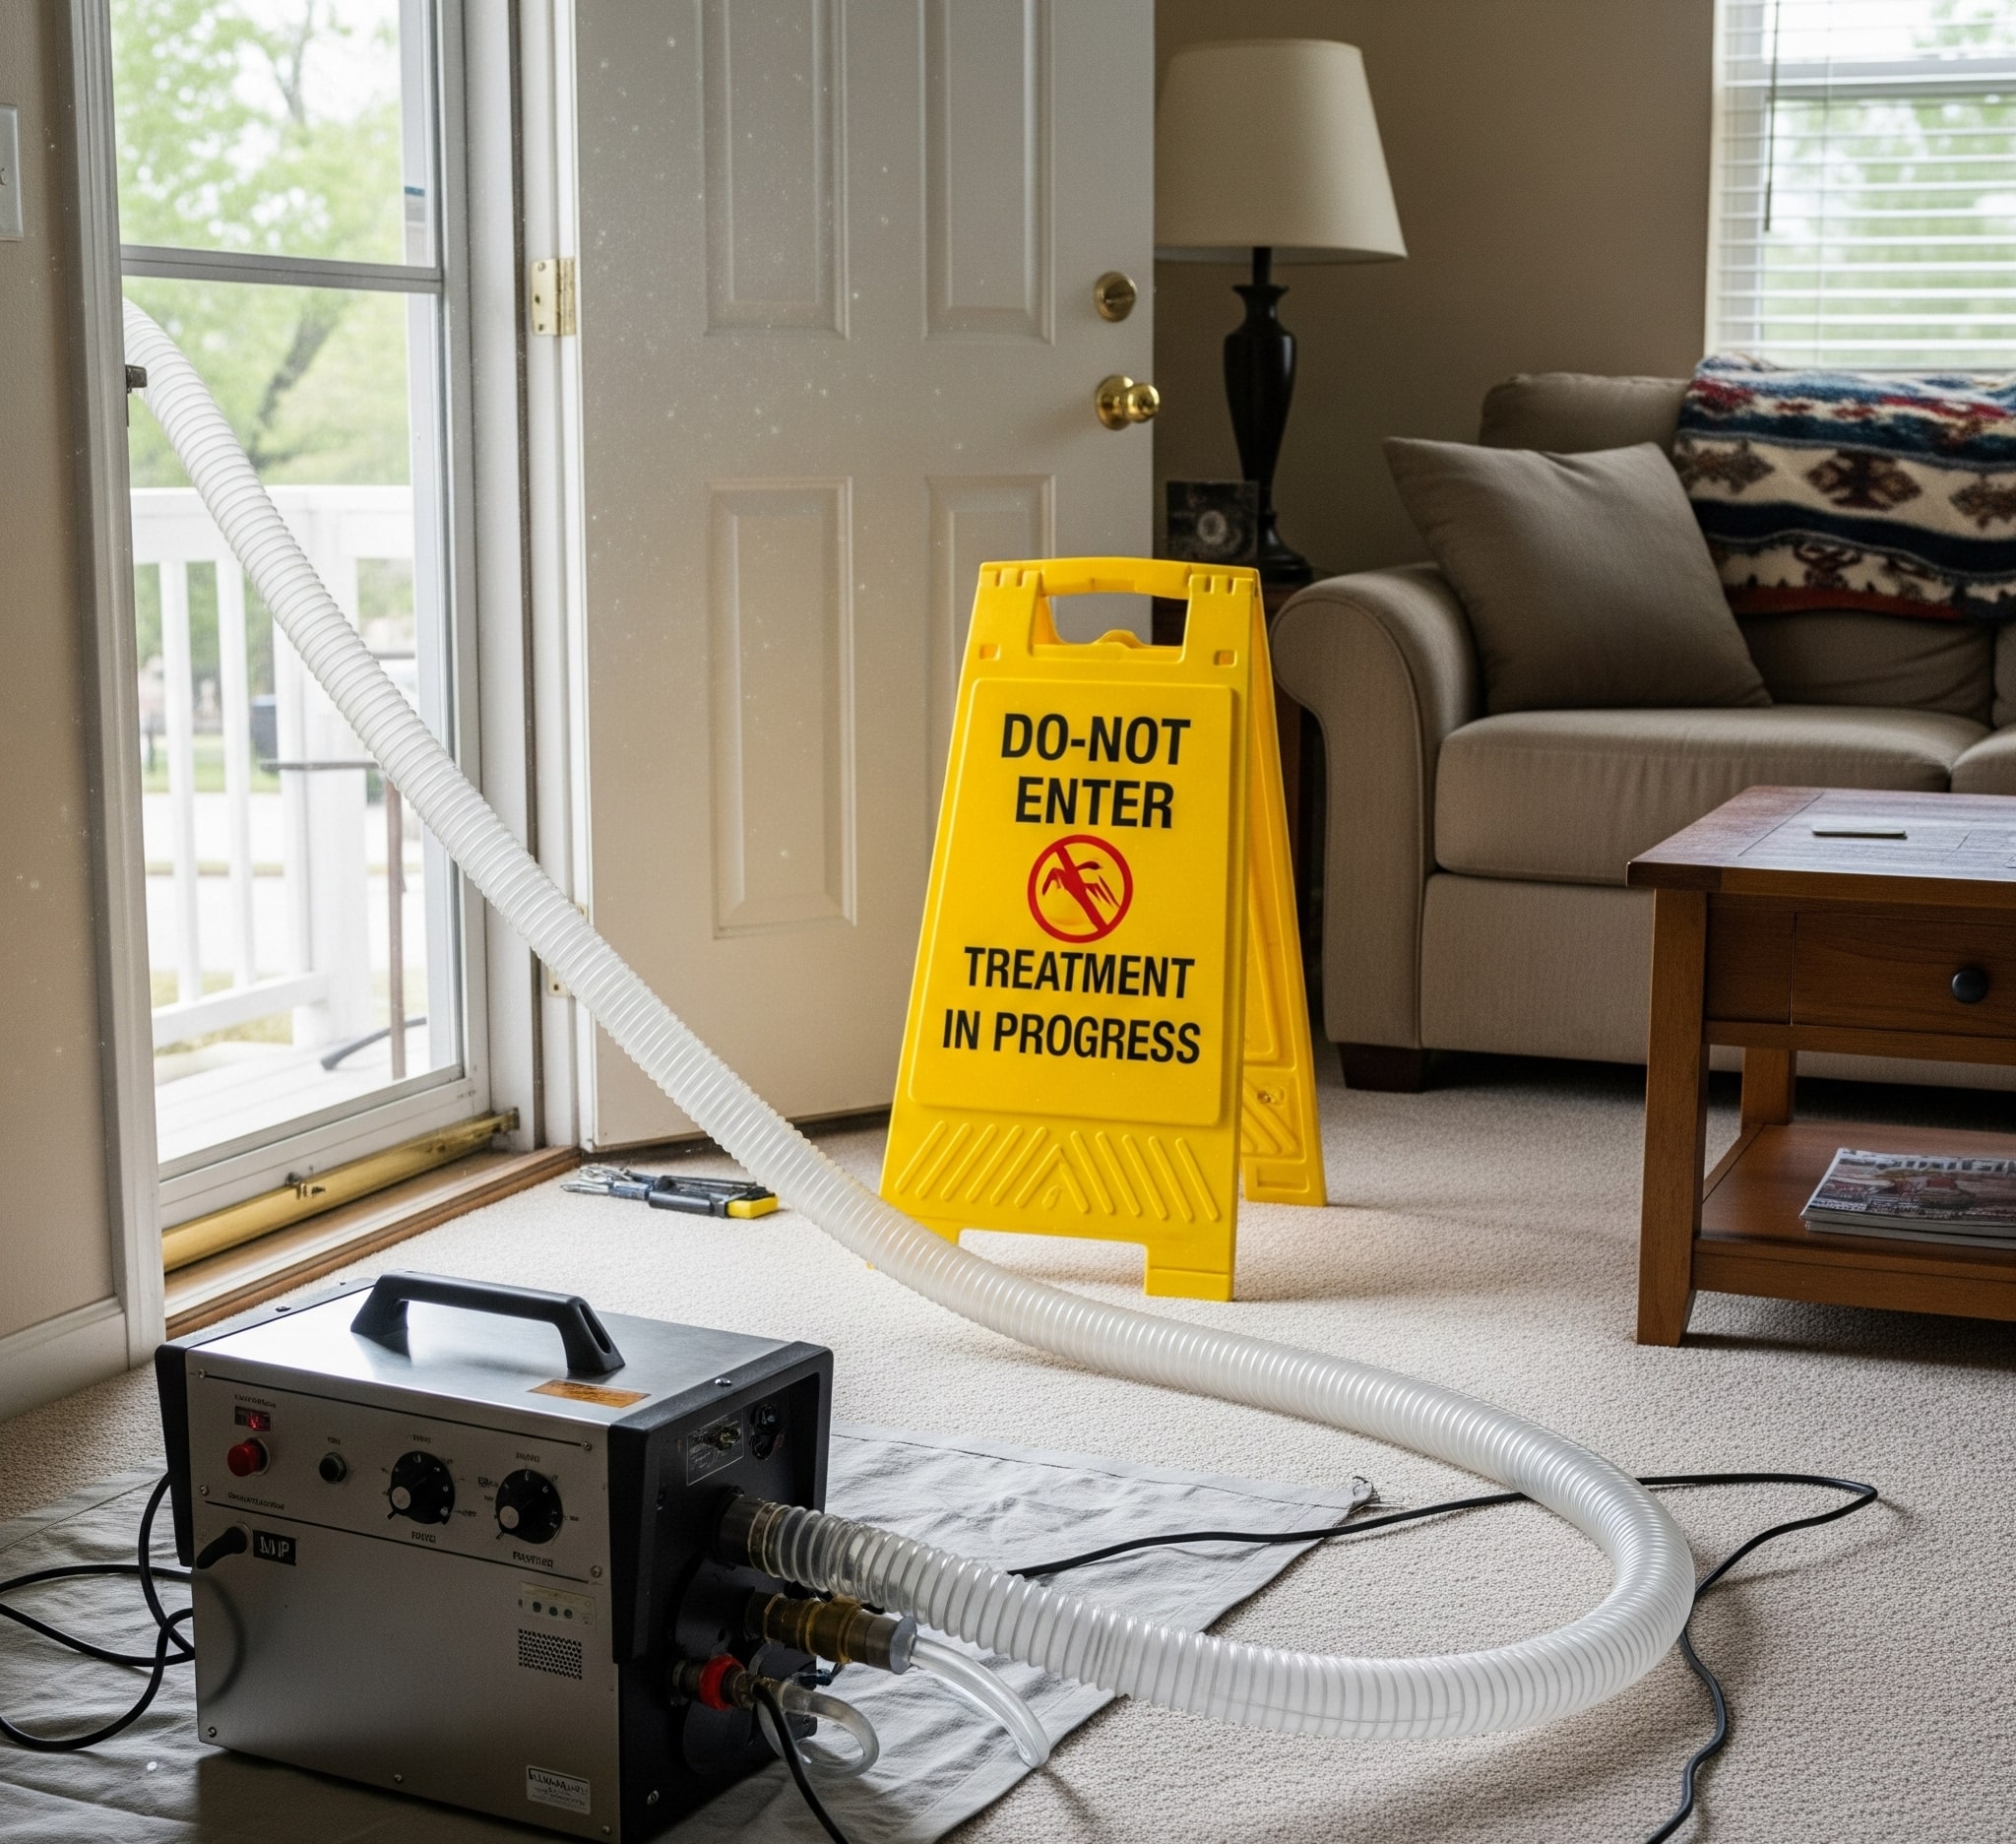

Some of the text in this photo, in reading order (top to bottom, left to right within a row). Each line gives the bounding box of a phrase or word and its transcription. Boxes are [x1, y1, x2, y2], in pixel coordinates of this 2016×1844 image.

[1001, 713, 1191, 765] DO-NOT
[1015, 776, 1174, 828] ENTER
[964, 946, 1195, 998] TREATMENT
[942, 1009, 1200, 1064] IN PROGRESS
